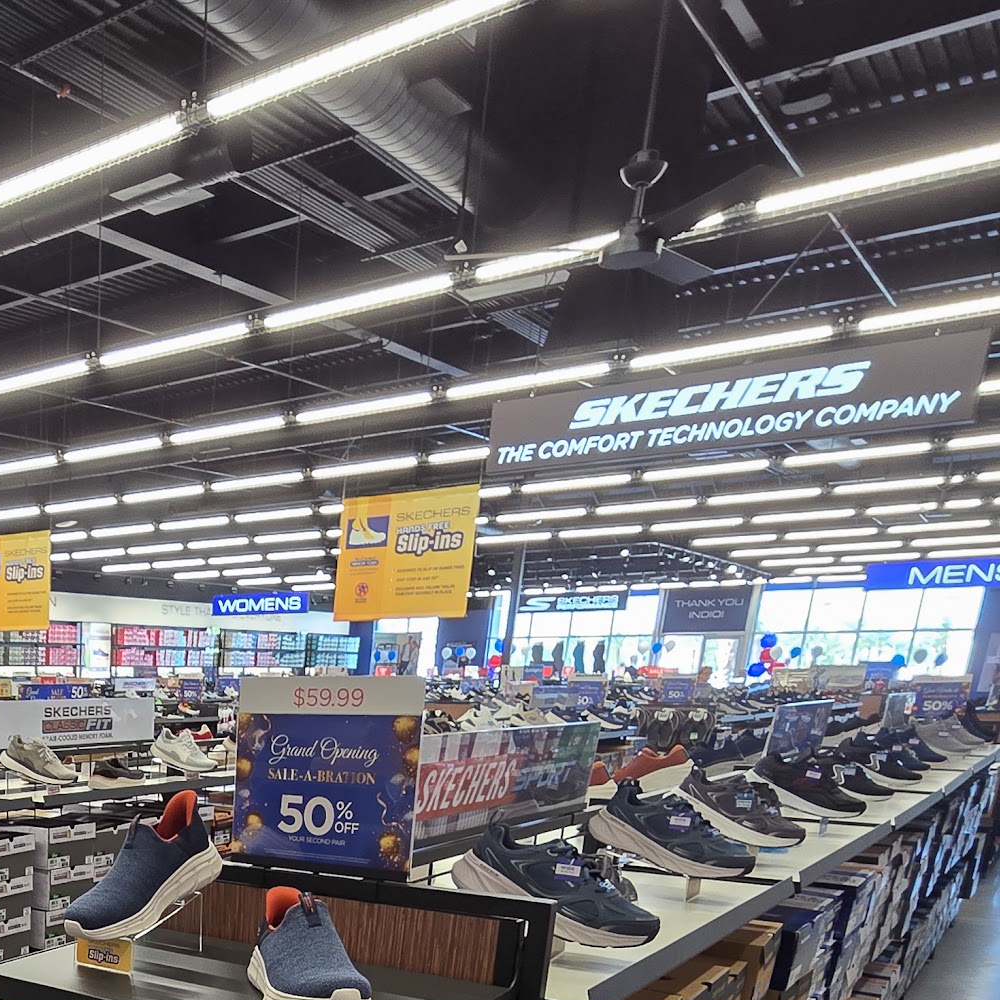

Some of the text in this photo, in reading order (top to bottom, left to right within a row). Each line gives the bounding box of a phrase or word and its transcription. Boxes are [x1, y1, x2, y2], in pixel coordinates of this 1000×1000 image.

[569, 361, 870, 430] SKECHERS
[497, 390, 961, 465] THE COMFORT TECHNOLOGY COMPANY
[396, 506, 471, 521] SKECHERS
[427, 521, 450, 530] FREE
[396, 530, 463, 556] Slip-ins
[4, 547, 47, 557] SKECHERS
[6, 563, 44, 583] Slip-ins
[162, 604, 212, 616] STYLE THA
[218, 596, 301, 613] WOMENS
[675, 597, 745, 608] THANK YOU
[688, 610, 725, 619] INDIO!
[293, 687, 365, 708] $59.99
[43, 706, 112, 717] SKECHERS
[923, 700, 953, 711] 50%
[43, 718, 112, 732] CLASSIC FIT
[268, 734, 380, 767] Grand Opening
[267, 768, 376, 785] SALE-A-BRATION
[416, 759, 576, 814] SKECHERS SPORT
[335, 821, 359, 835] OFF
[288, 835, 346, 847] YOUR SECOND PAIR
[88, 949, 119, 965] Slip-ins
